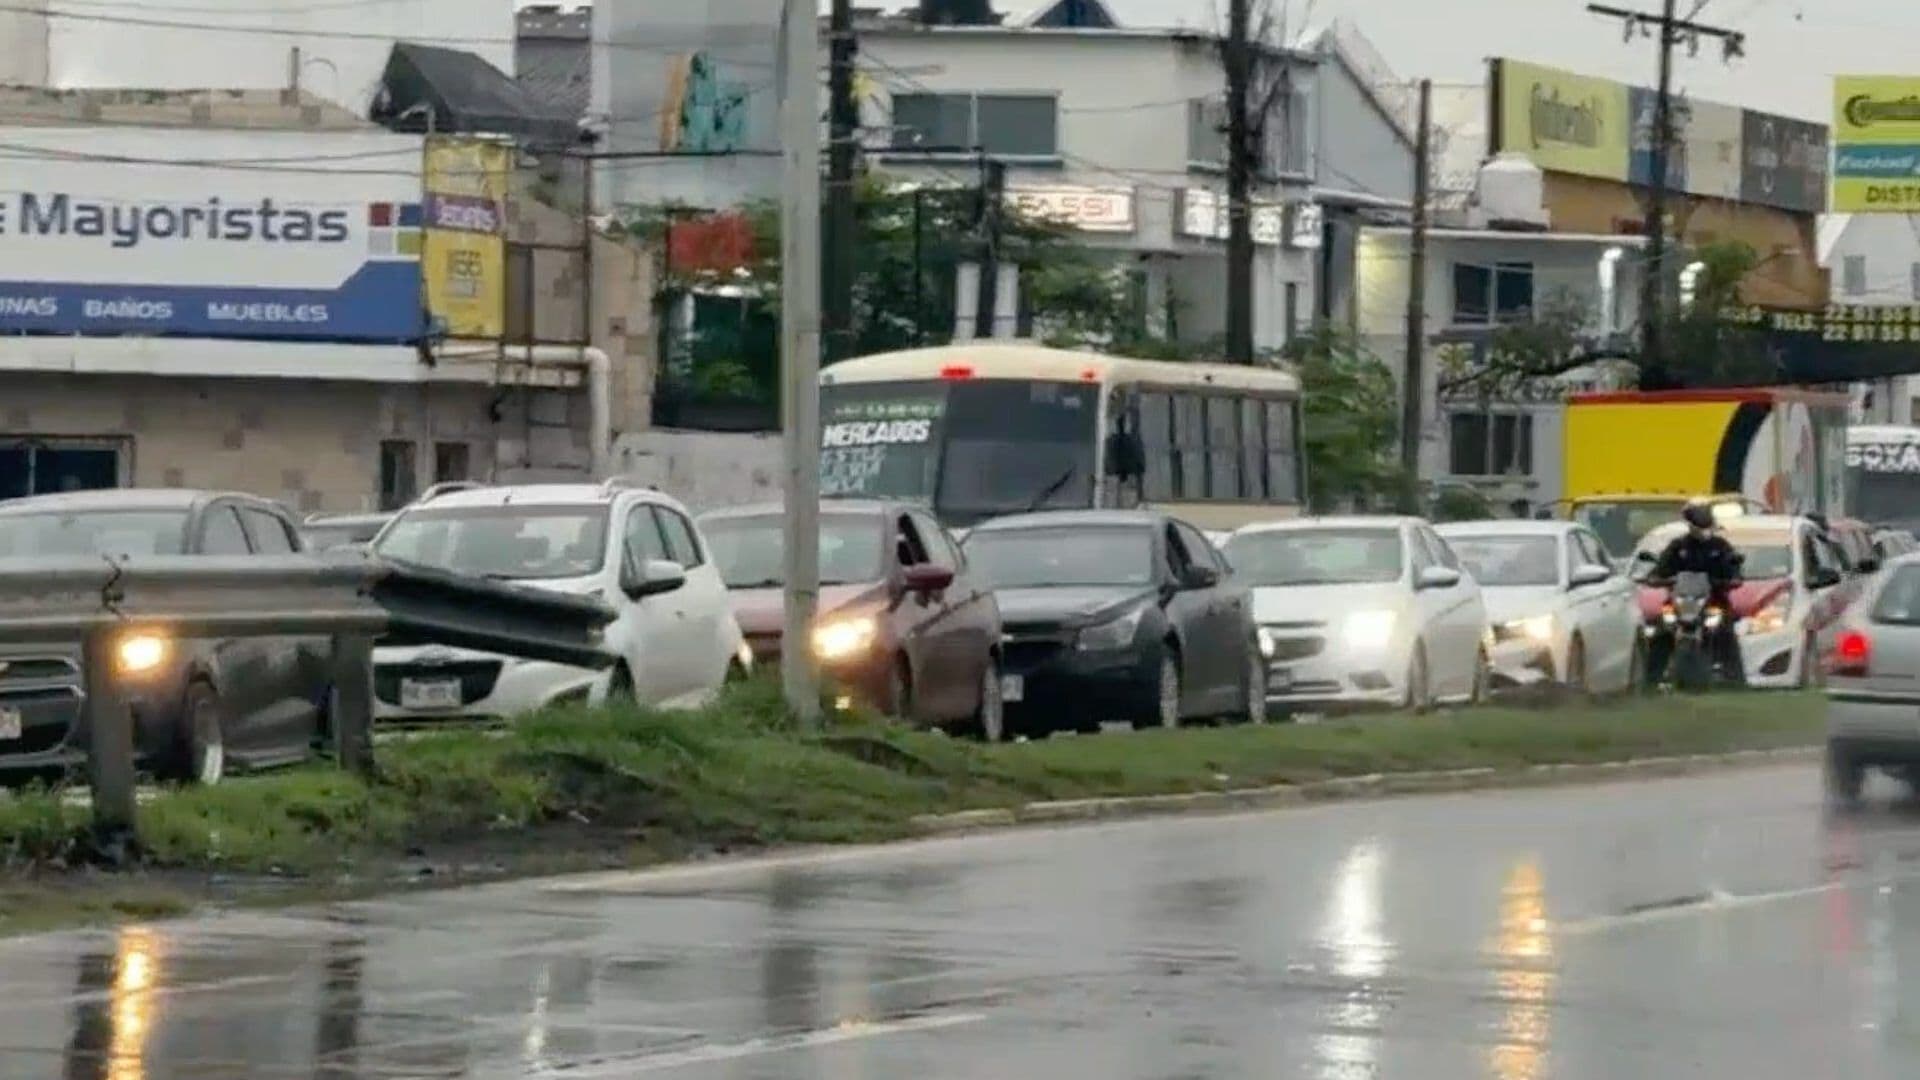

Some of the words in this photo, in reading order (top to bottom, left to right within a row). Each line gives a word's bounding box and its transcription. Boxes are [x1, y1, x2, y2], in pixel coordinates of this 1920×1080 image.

[1866, 186, 1920, 203] DIST
[20, 192, 348, 247] Mayoristas
[85, 297, 173, 318] BAÑOS
[207, 301, 329, 322] MUEBLES
[823, 419, 932, 447] MERCADOS
